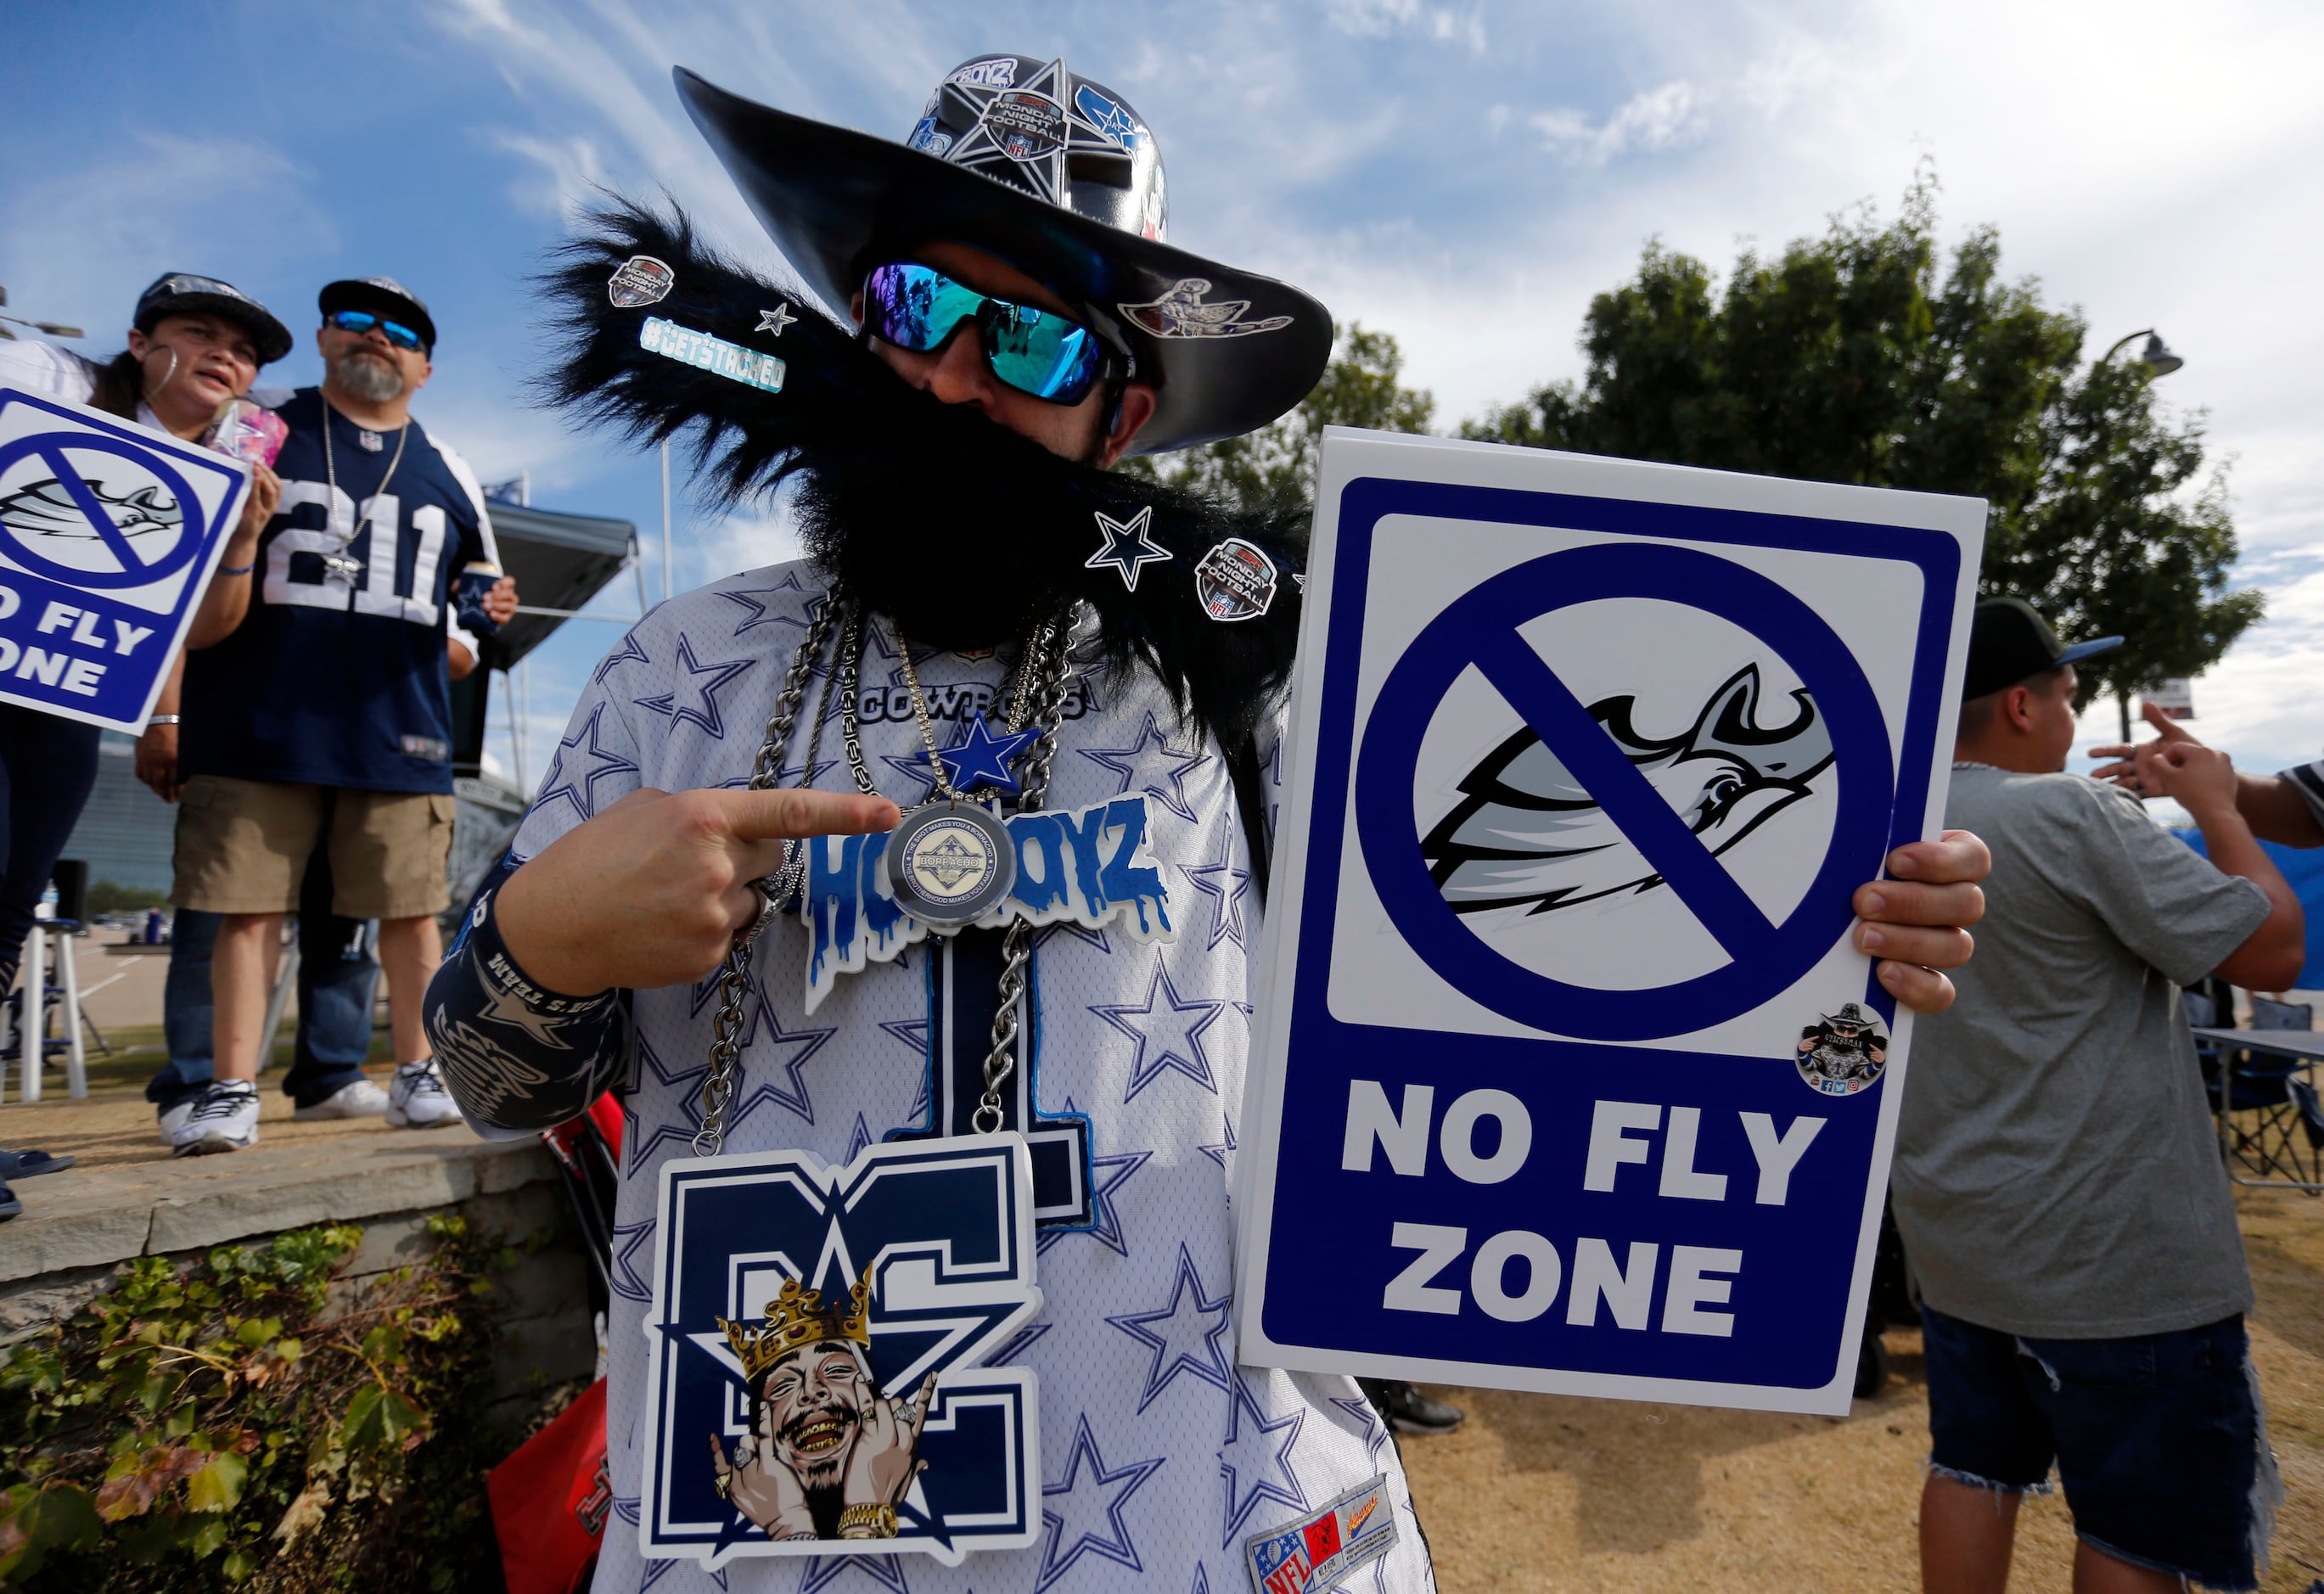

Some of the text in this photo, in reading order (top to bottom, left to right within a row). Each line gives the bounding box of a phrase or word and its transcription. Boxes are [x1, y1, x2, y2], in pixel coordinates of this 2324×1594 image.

[985, 114, 1065, 143] FOOTBALL
[996, 102, 1063, 125] MONDAY
[1003, 109, 1053, 128] NIGHT
[1008, 144, 1027, 158] NFL
[614, 276, 661, 299] FOOTBALL
[624, 267, 668, 287] MONDAY
[626, 274, 660, 289] NIGHT
[1215, 550, 1269, 590] MONDAY
[1220, 561, 1259, 592] NIGHT
[1201, 563, 1266, 609] FOOTBALL
[0, 585, 155, 656] O FLY
[1209, 601, 1227, 618] NFL
[0, 637, 108, 698] ONE
[907, 842, 917, 855] THE
[915, 828, 929, 844] SHOT
[929, 821, 952, 833] MAKES
[952, 821, 966, 829] YOU
[969, 827, 994, 857] BORRACHO
[919, 856, 979, 867] BORRACHO
[907, 874, 948, 904] BROTHERHOOD
[948, 894, 971, 904] MAKES
[970, 886, 983, 895] YOU
[980, 866, 994, 889] FAMILY
[487, 952, 544, 1006] TEAM
[1341, 1079, 1828, 1206] NO FLY
[1383, 1221, 1743, 1337] ZONE
